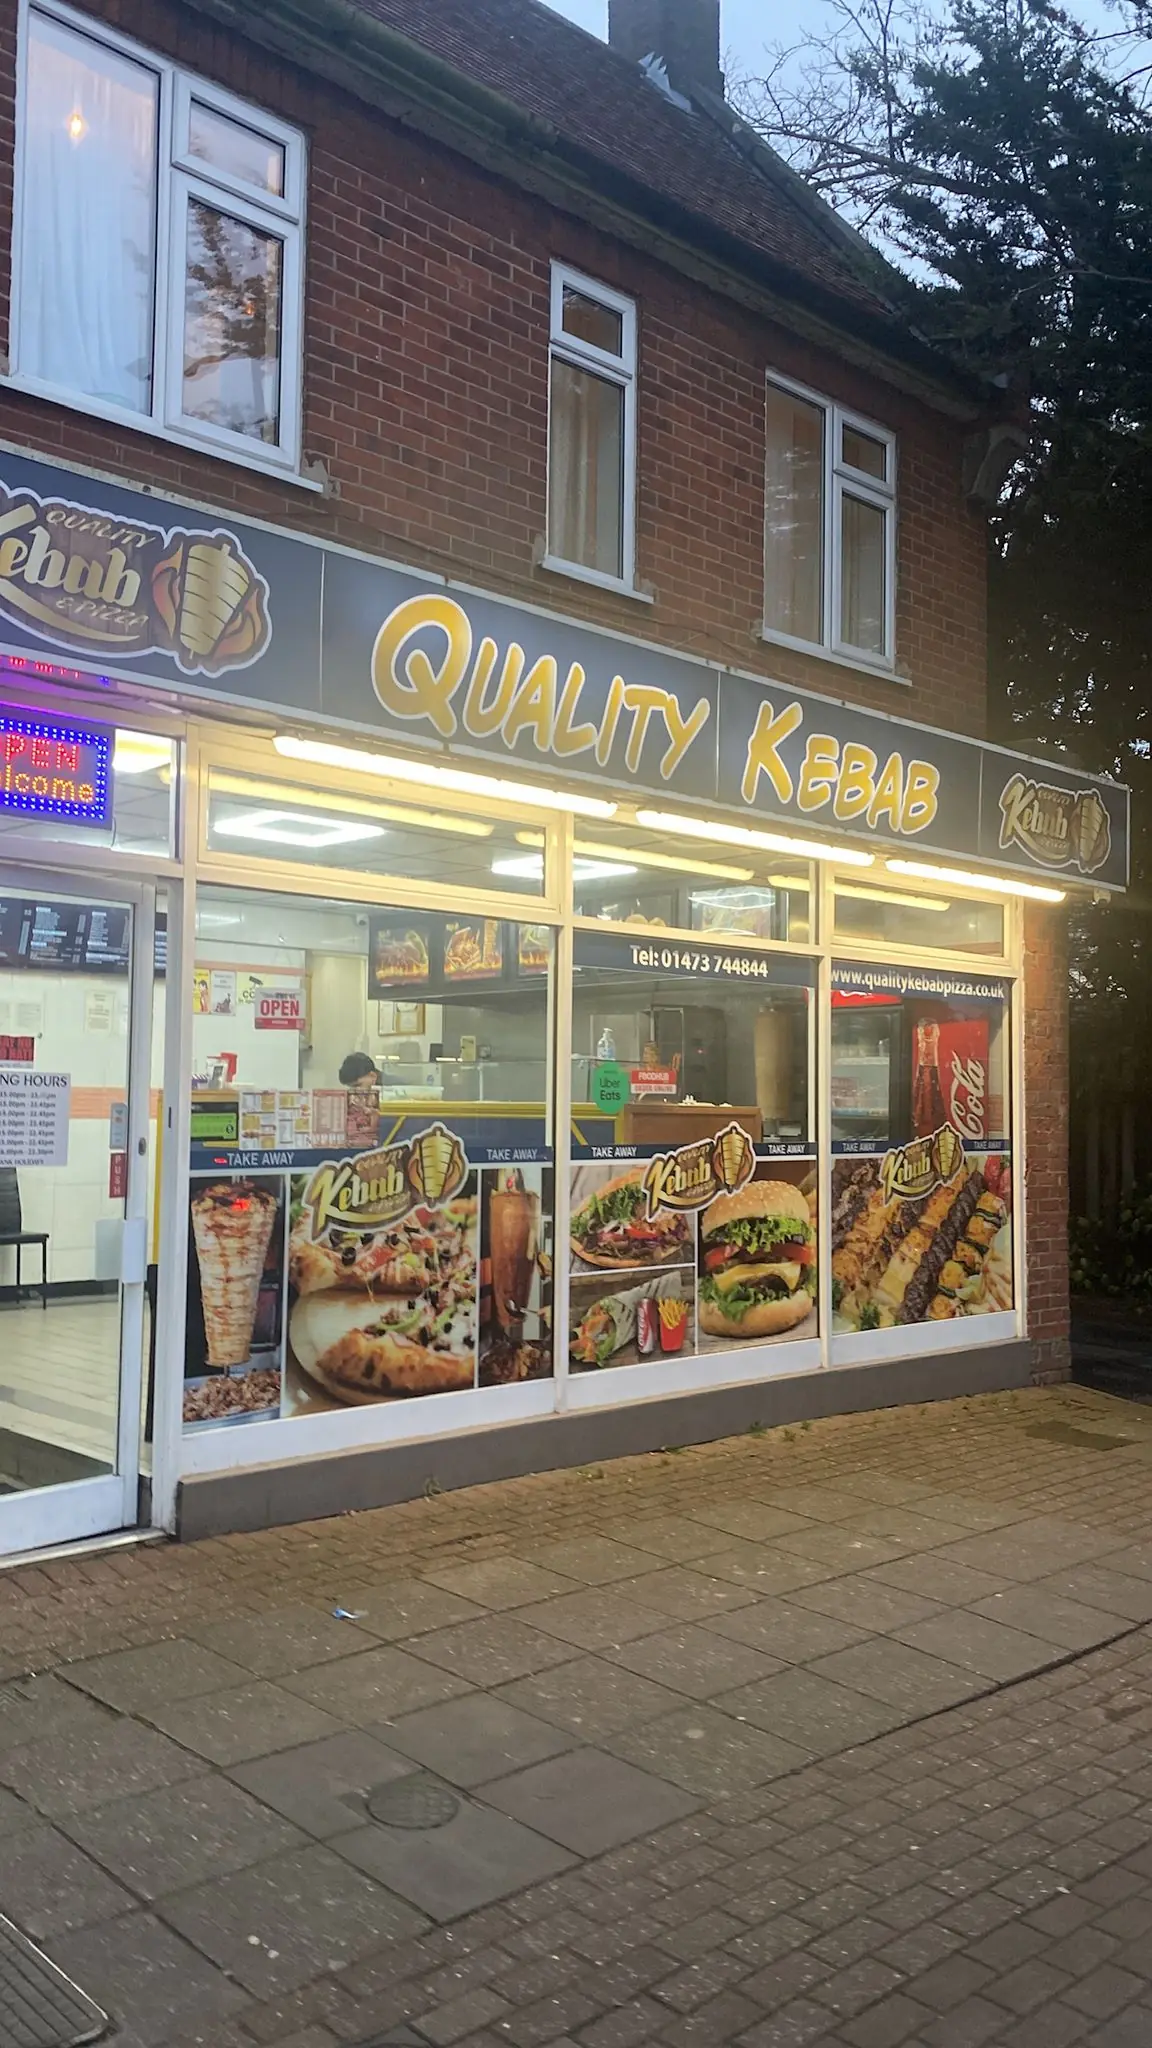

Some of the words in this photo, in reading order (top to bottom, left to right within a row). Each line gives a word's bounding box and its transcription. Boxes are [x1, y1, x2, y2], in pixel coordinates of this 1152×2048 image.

[46, 509, 155, 549] QUALITY
[371, 593, 711, 781] QUALITY
[740, 699, 941, 836] KEBAB
[0, 732, 79, 772] PEN
[630, 944, 660, 968] Tel:
[661, 951, 710, 973] 01473
[713, 955, 769, 978] 744844
[831, 968, 1005, 999] www.qualitykebabpizza.co.uk
[260, 999, 300, 1017] OPEN
[24, 1074, 68, 1087] HOURS
[599, 1077, 621, 1088] Uber
[600, 1090, 622, 1101] Eats
[951, 1049, 985, 1140] Cola
[486, 1148, 511, 1161] TAKE
[512, 1148, 538, 1160] AWAY
[591, 1146, 613, 1157] TAKE
[614, 1146, 638, 1157] AWAY
[768, 1144, 785, 1155] TAKE
[785, 1144, 805, 1154] AWAY
[842, 1142, 859, 1152] TAKE
[859, 1142, 877, 1152] AWAY
[227, 1152, 259, 1167] TAKE
[261, 1152, 295, 1165] AWAY
